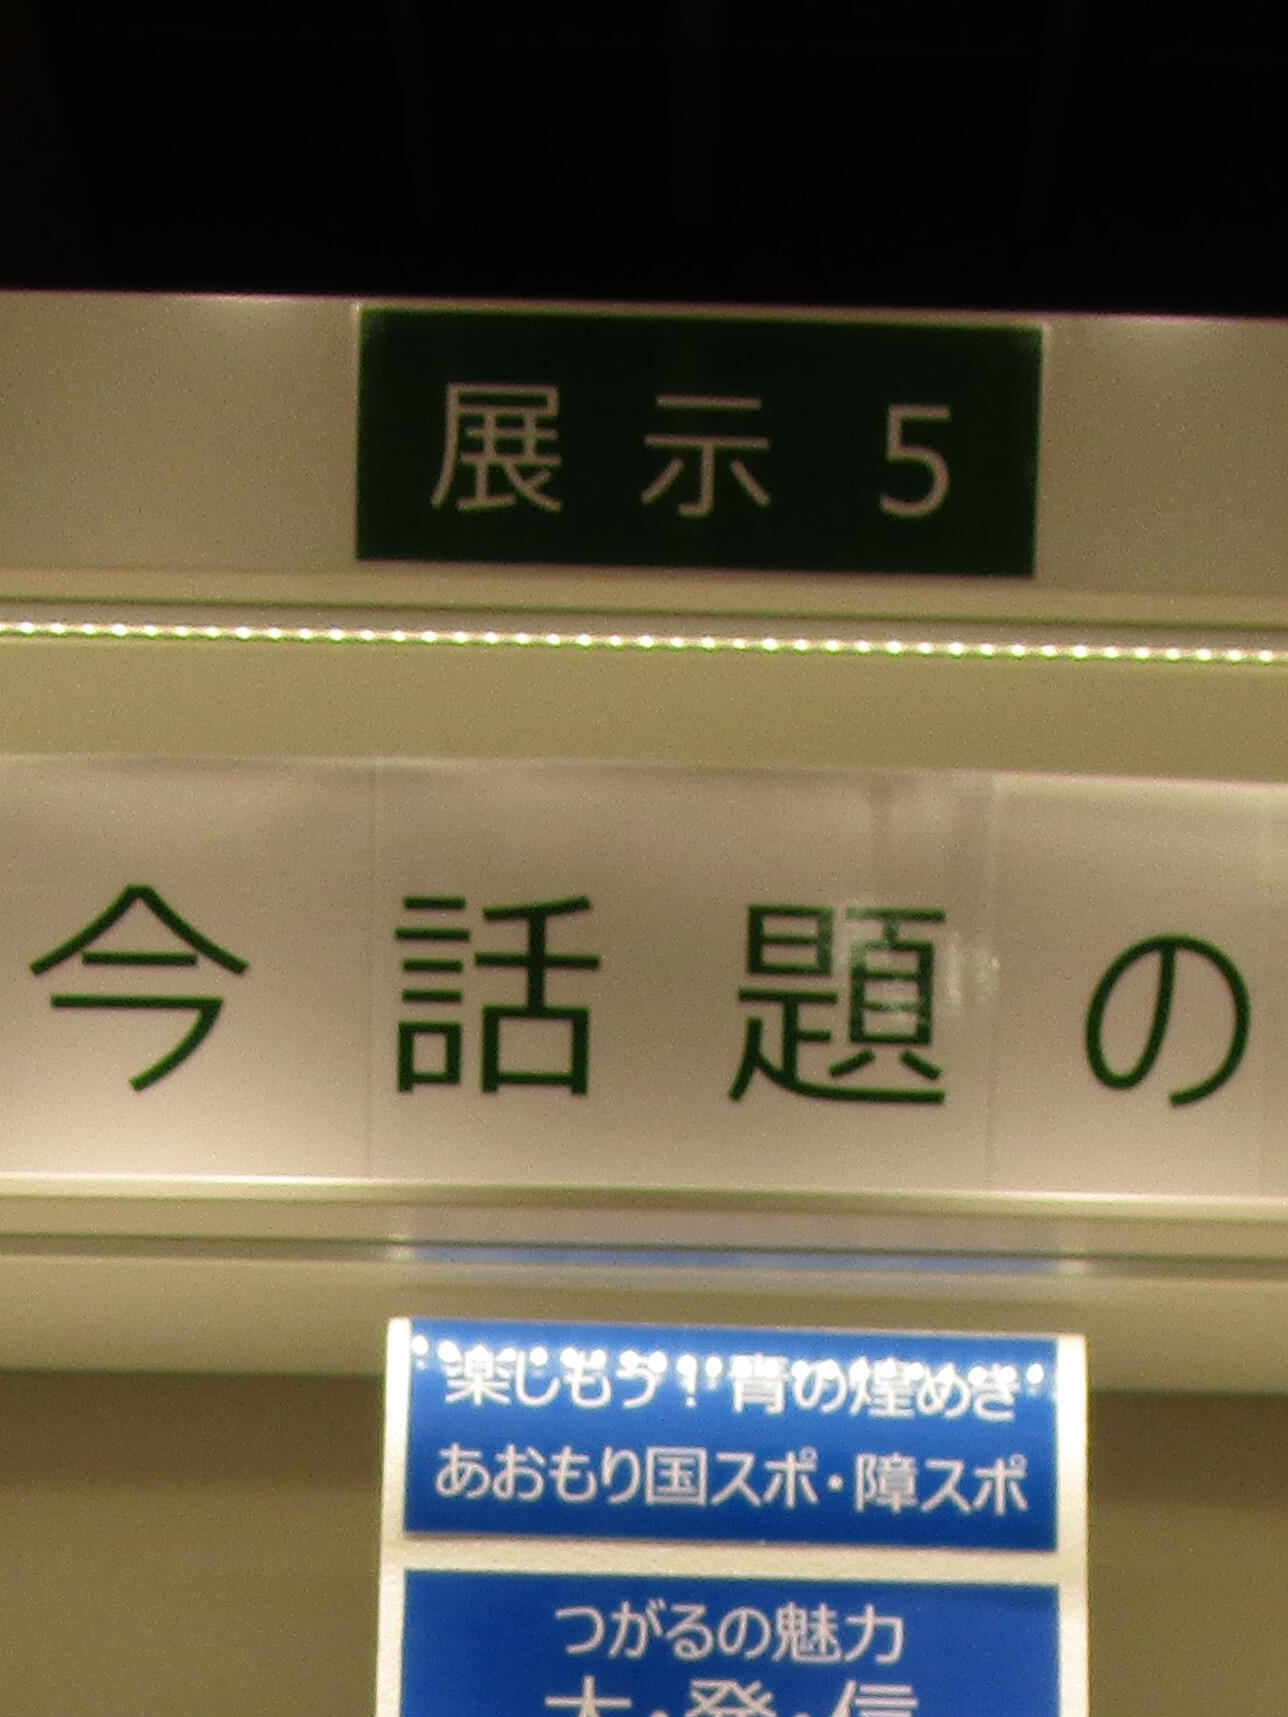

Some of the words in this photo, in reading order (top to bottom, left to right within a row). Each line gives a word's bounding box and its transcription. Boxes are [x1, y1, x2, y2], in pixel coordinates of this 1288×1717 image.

[434, 1441, 1029, 1516] あおもり国スポ・障スポ
[554, 1599, 906, 1666] つがるの魅力
